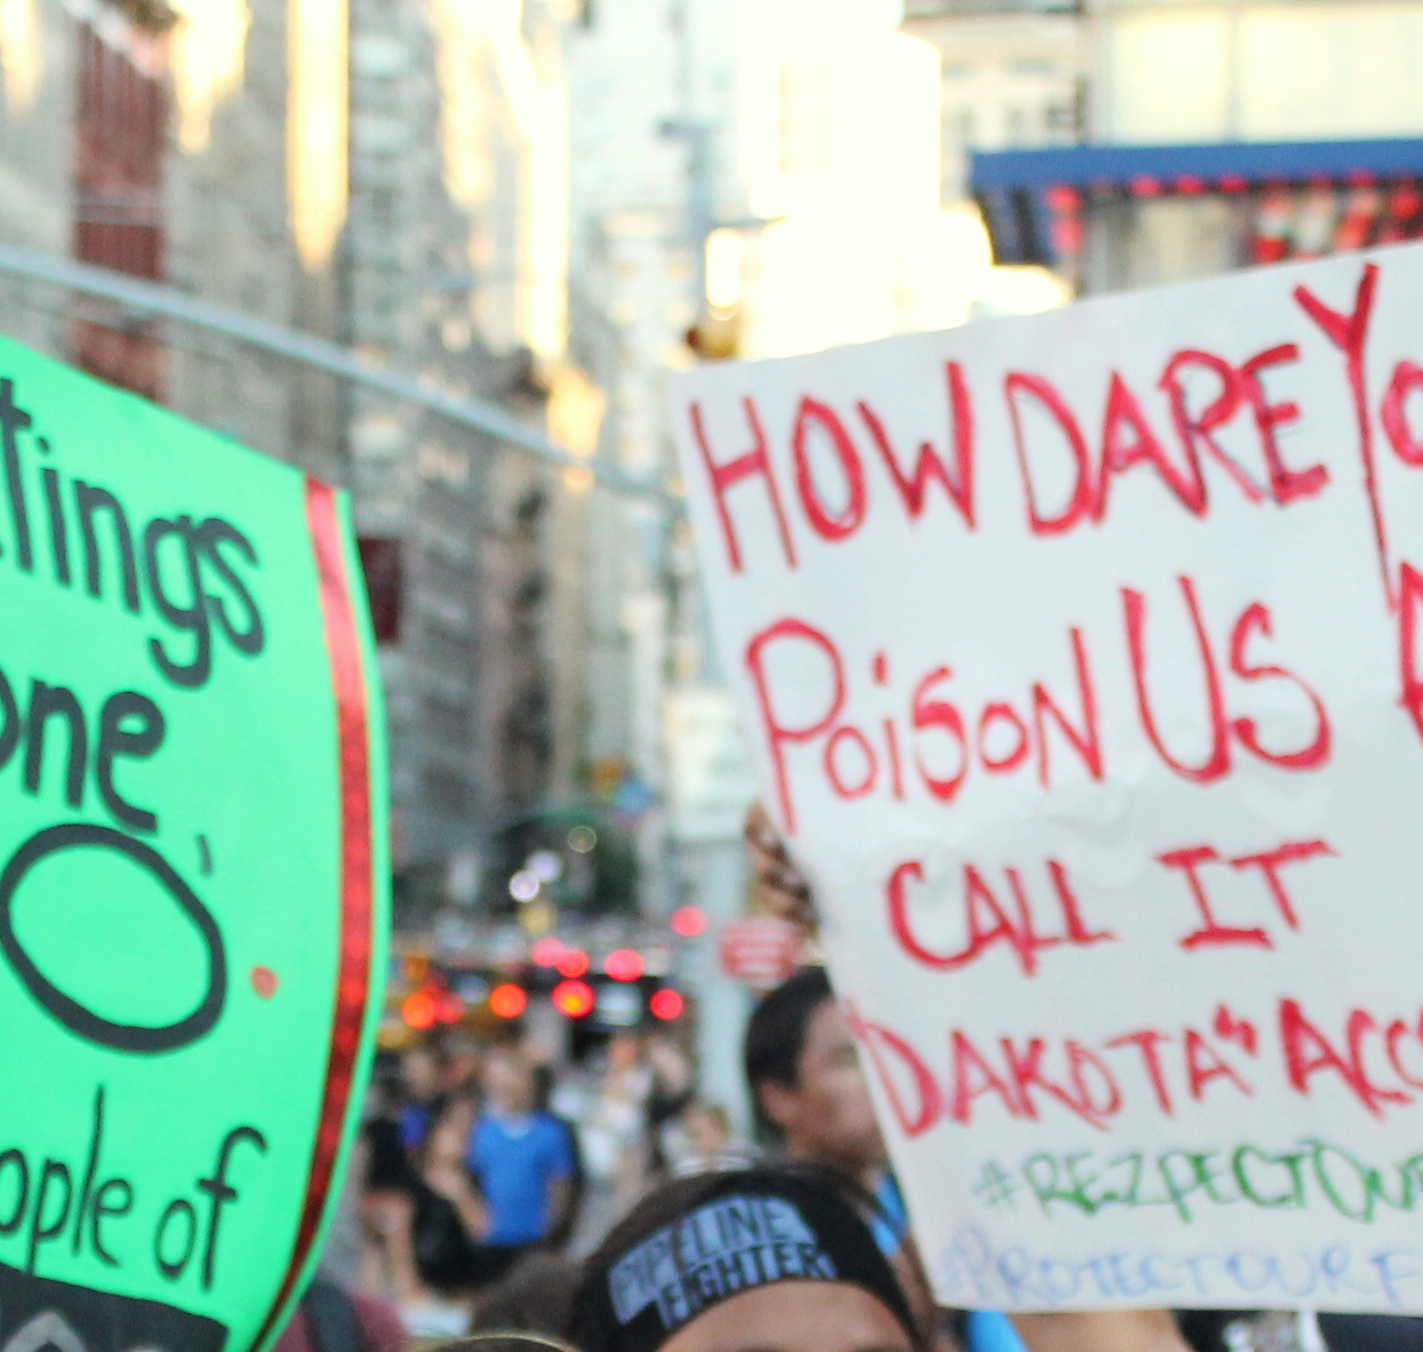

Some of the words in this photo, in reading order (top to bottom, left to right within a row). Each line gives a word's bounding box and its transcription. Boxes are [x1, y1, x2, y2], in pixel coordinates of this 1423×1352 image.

[690, 360, 977, 573] HOW
[1002, 343, 1331, 536] DARE
[1119, 574, 1332, 783] US
[886, 859, 1118, 978] CALL
[1153, 839, 1340, 951] IT
[153, 1126, 268, 1293] of
